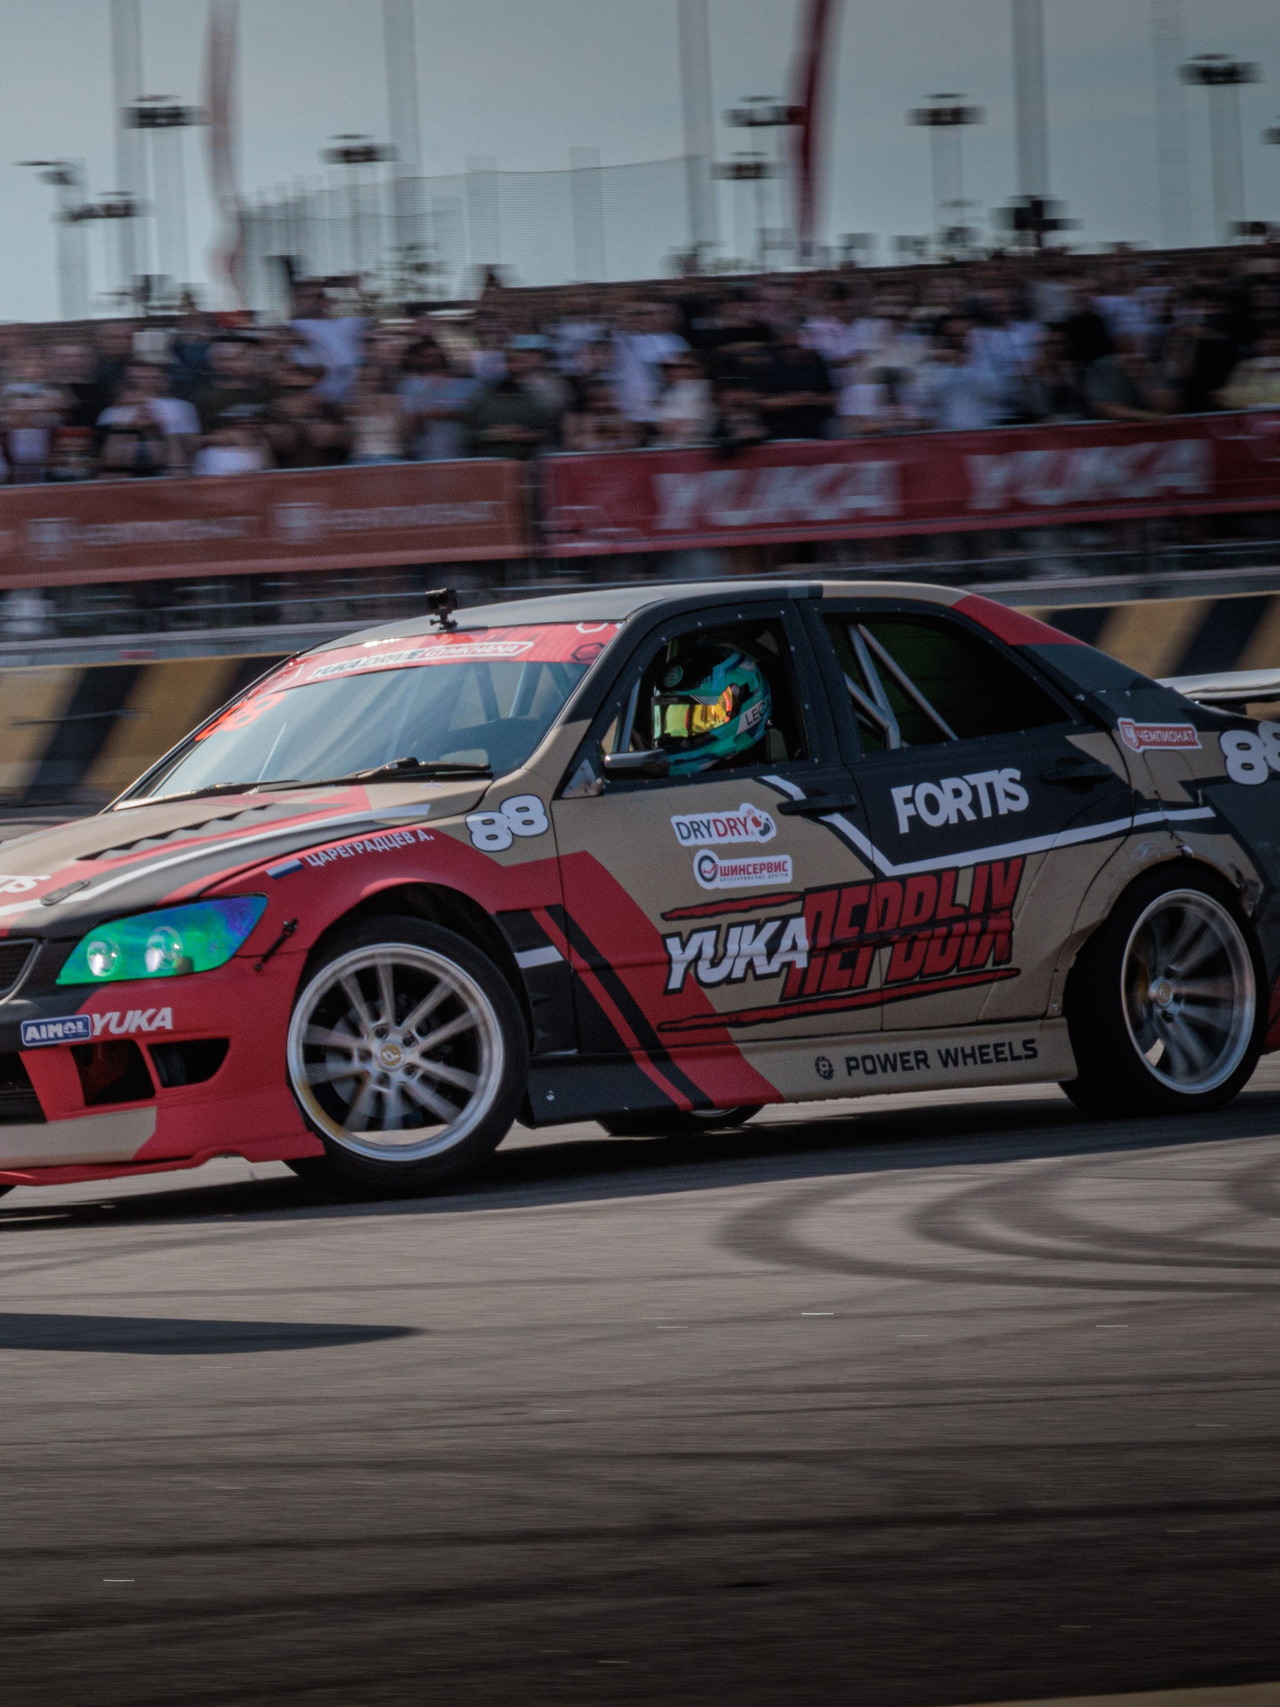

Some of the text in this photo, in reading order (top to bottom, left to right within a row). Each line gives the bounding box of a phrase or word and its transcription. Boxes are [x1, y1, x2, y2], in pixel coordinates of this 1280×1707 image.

[652, 438, 1213, 529] YUKA YUKA
[1136, 730, 1196, 743] ЧЕМПИОНАТ
[890, 767, 1029, 834] FORTIS
[465, 794, 549, 852] 88
[675, 816, 749, 840] DRYDRY
[304, 829, 435, 867] ЦАРЕГРАДЦЕВ А.
[720, 861, 788, 877] ШИНСЕРВИС
[665, 916, 810, 990] YUKA
[25, 1020, 89, 1041] AIMOL
[91, 1007, 174, 1036] YUKA
[845, 1039, 1039, 1077] POWER WHEELS
